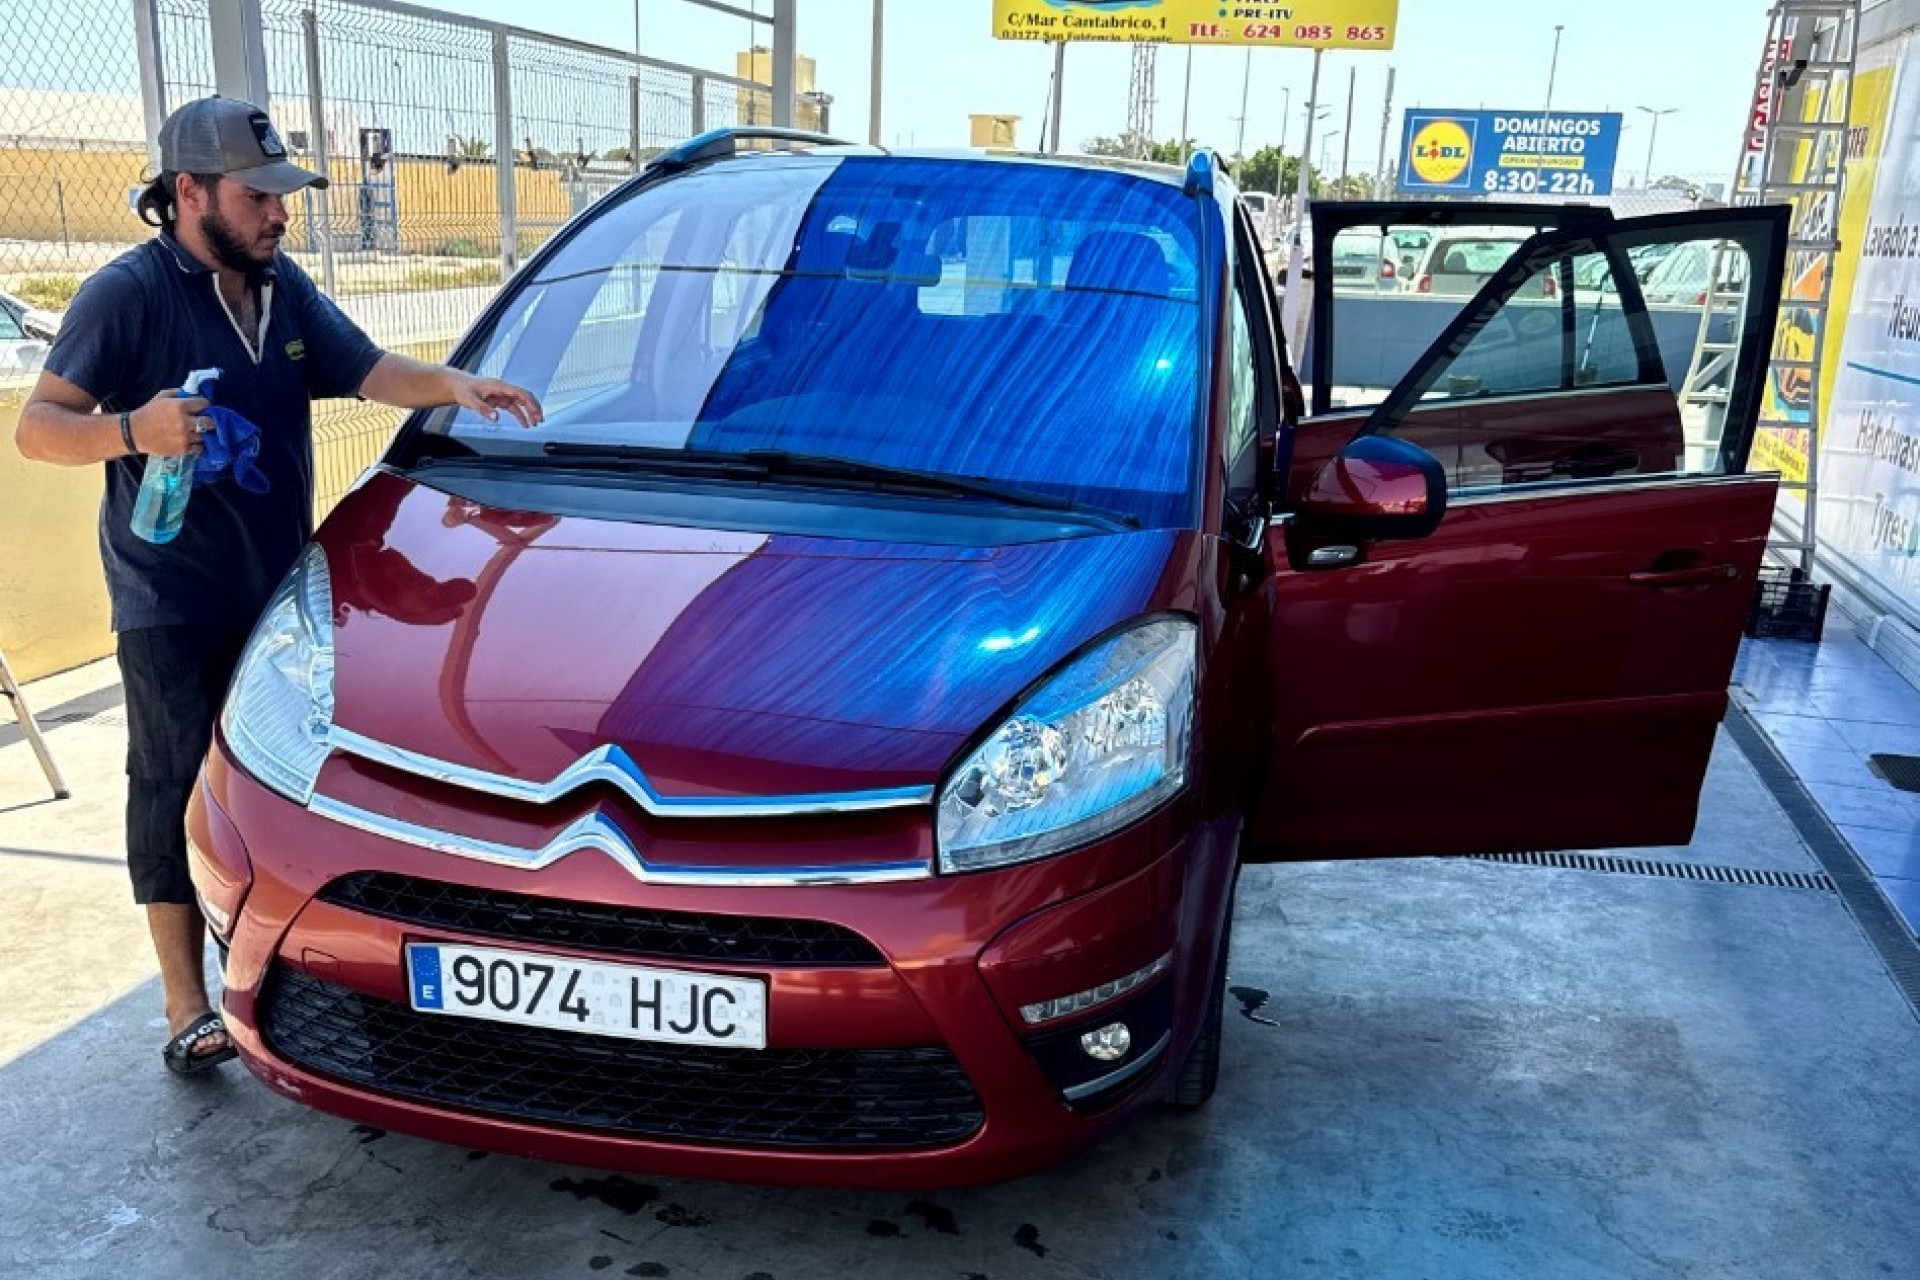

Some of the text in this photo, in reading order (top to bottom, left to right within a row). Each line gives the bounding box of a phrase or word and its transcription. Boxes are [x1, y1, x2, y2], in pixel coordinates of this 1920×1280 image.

[1007, 13, 1058, 29] C/Mar
[1233, 8, 1293, 20] PRE-ITV
[1243, 24, 1281, 39] 624
[1494, 117, 1601, 136] DOMINGOS
[1502, 136, 1585, 153] ABIERTO
[1863, 212, 1908, 258] Lavado
[1871, 492, 1909, 551] Tyres
[422, 984, 434, 999] E
[452, 954, 736, 1038] 9074 HJC
